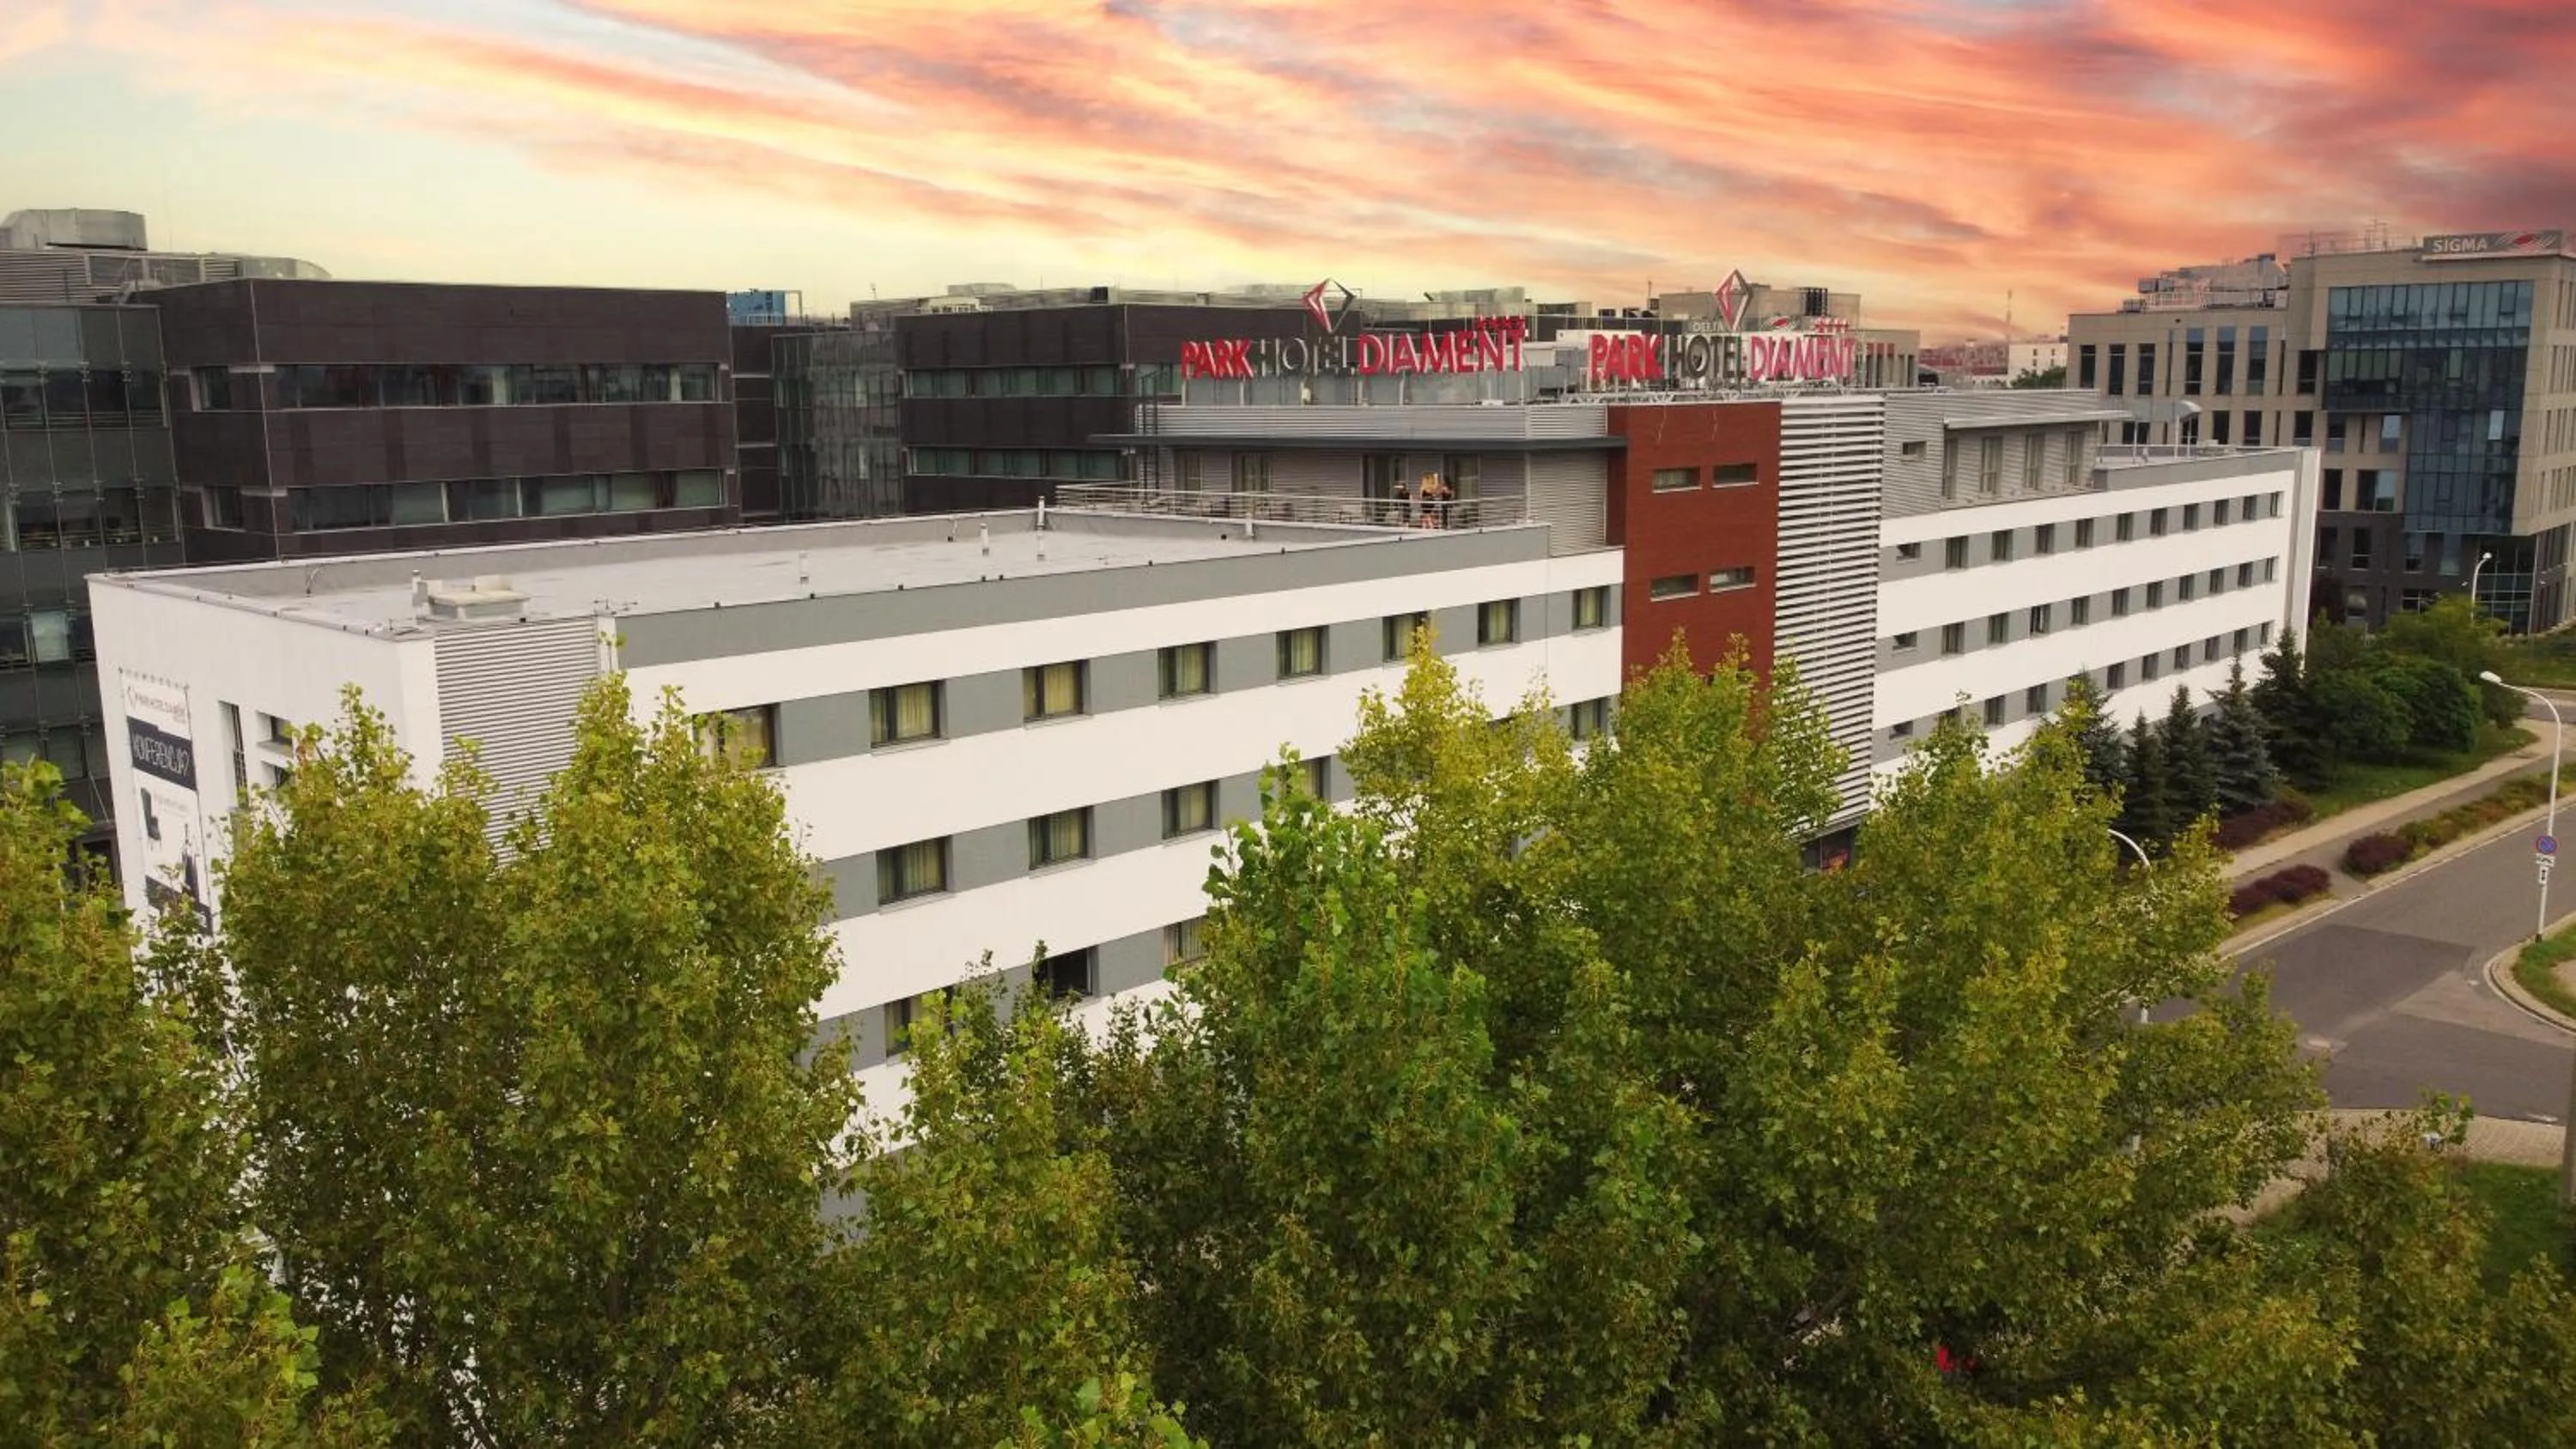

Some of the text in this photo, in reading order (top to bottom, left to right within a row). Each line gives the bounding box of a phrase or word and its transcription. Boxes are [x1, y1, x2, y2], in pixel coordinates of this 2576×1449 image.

[2433, 238, 2488, 252] SIGMA
[1182, 338, 1255, 378] PARK
[1359, 330, 1525, 374] DIAMENT
[1591, 334, 1856, 383] PARK HOTEL DIAMENT
